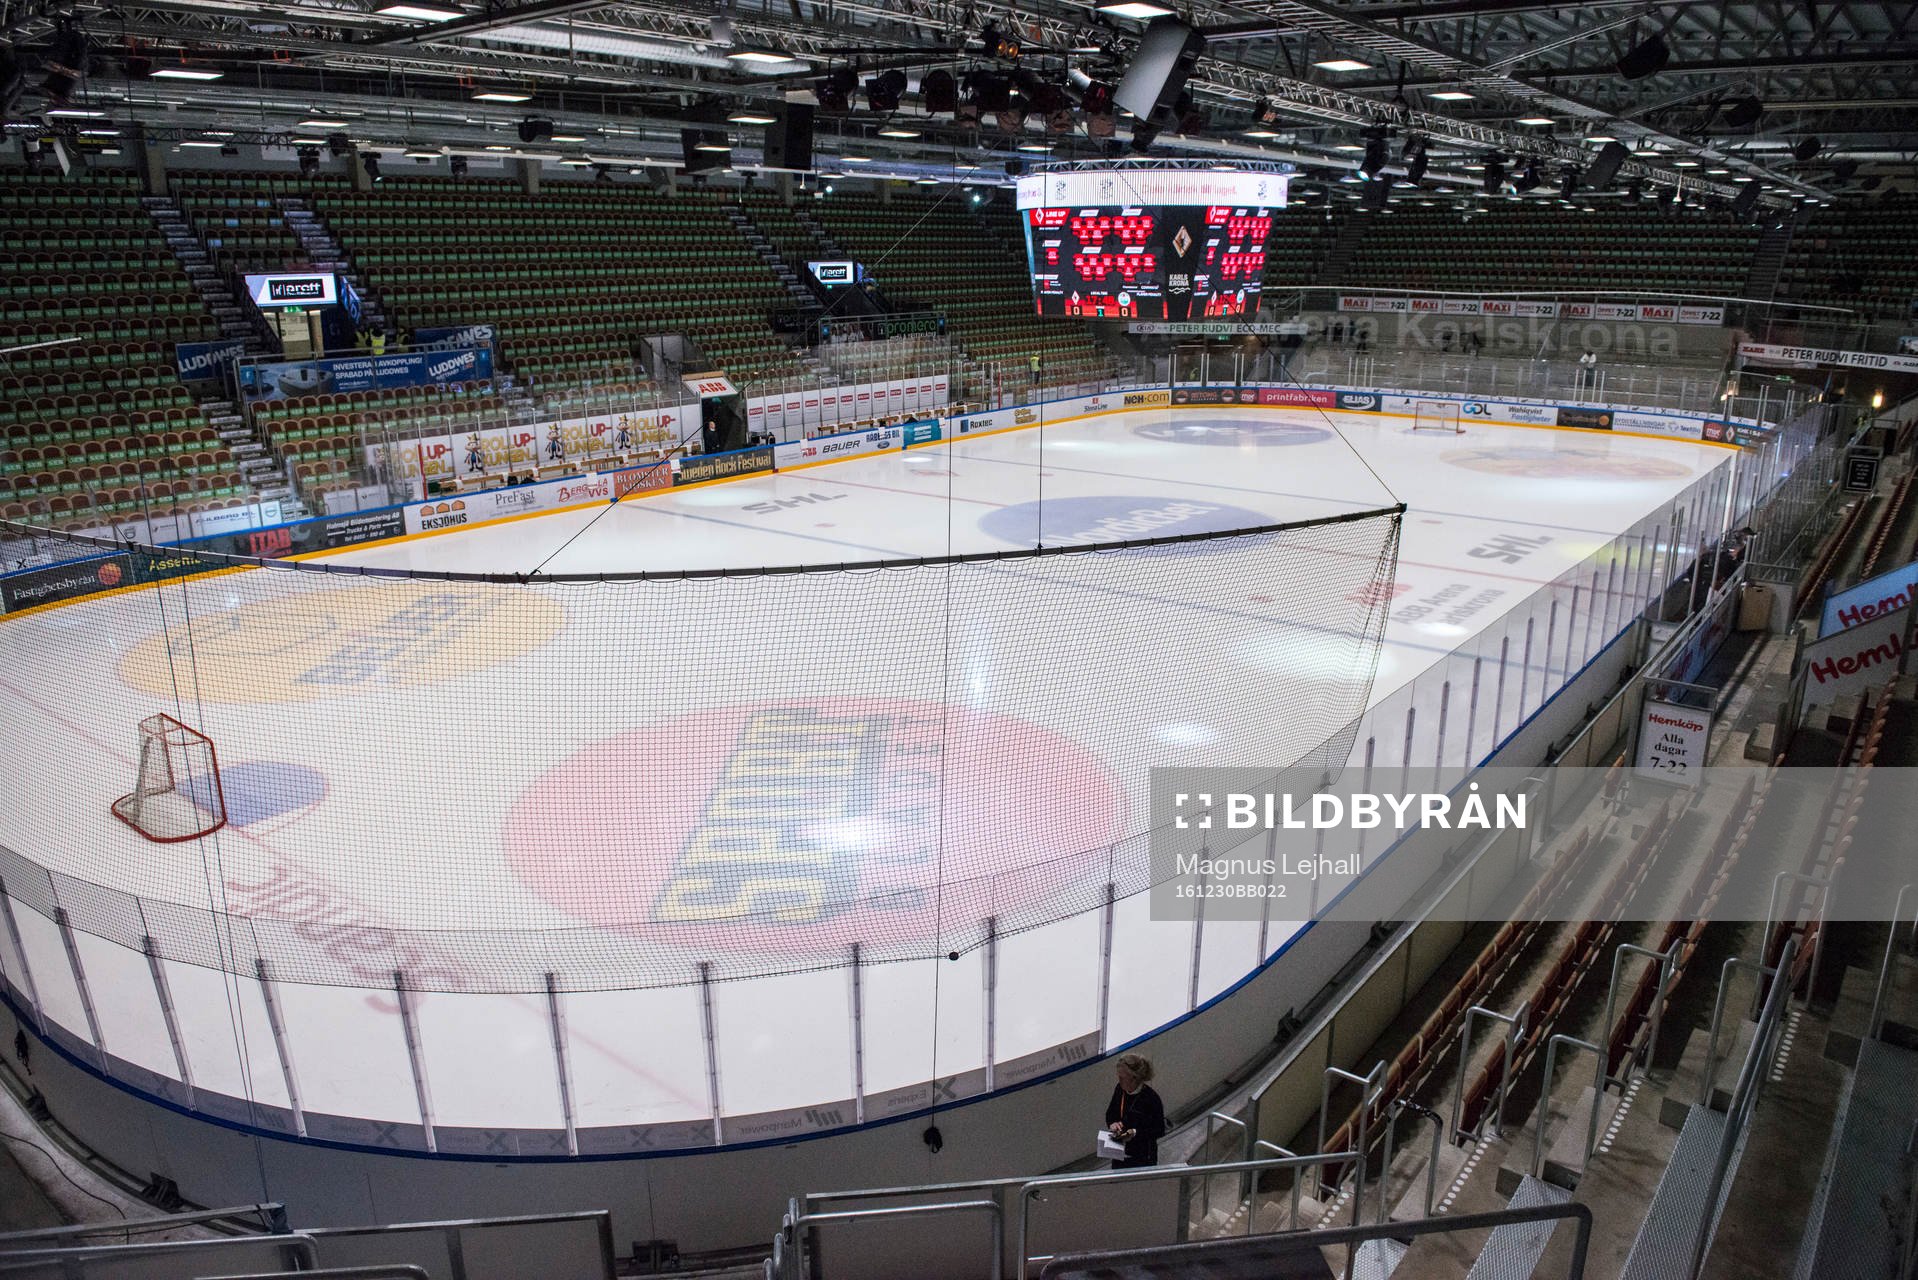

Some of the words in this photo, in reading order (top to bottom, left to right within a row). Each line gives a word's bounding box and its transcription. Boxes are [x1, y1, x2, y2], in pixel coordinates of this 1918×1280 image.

[1343, 299, 1369, 308] MAXI
[1412, 301, 1438, 310] MAXI
[1461, 304, 1477, 312] 7-22
[1483, 302, 1511, 313] MAXI
[1535, 306, 1553, 314] 7-22
[1560, 304, 1590, 316] MAXI
[1616, 308, 1634, 317] 7-22
[1642, 306, 1674, 318] MAXI
[1701, 311, 1721, 321] 7-22
[1169, 324, 1199, 333] PETER
[1201, 324, 1233, 333] RUDVI
[1236, 324, 1281, 333] ECO-MEC
[1397, 311, 1678, 357] Karlskrona
[1782, 348, 1812, 360] PETER
[1814, 349, 1848, 363] RUDVI
[1851, 353, 1888, 367] FRITID
[428, 352, 476, 377] LUDDWES
[698, 382, 727, 394] ABB
[1266, 392, 1328, 403] printfabriken
[970, 418, 993, 429] Roxtec
[822, 439, 861, 454] BAUER
[715, 458, 737, 474] Rock
[737, 453, 772, 472] Festival
[495, 490, 535, 505] PreFast
[589, 487, 609, 497] VVS
[741, 493, 848, 515] SHL
[249, 528, 292, 553] ITAB
[1467, 533, 1553, 565] SHL
[1391, 600, 1434, 625] ABB
[1429, 583, 1471, 608] Arena
[1648, 713, 1704, 732] Hemköp
[1661, 733, 1684, 745] Alla
[1654, 742, 1688, 756] dagar
[1650, 756, 1687, 776] 7-22
[646, 708, 890, 925] SPORT
